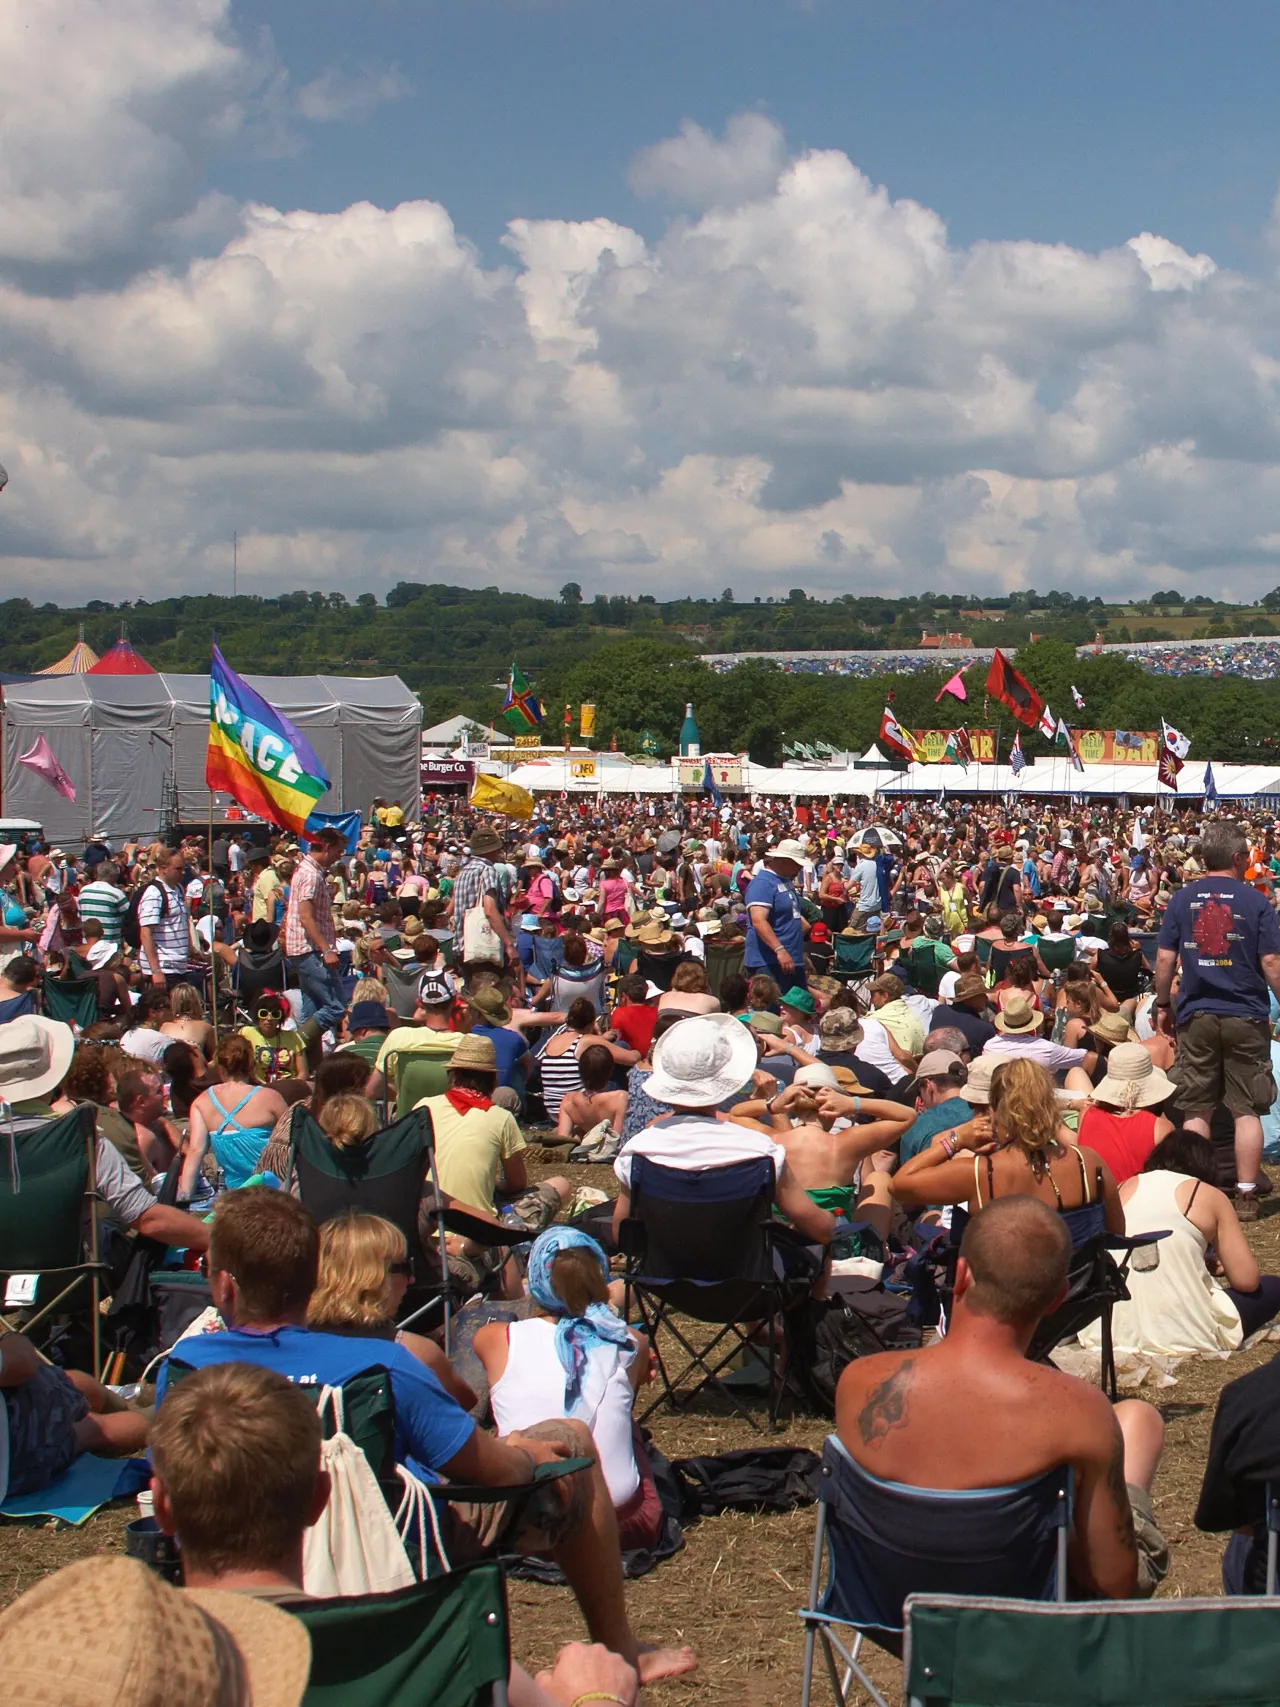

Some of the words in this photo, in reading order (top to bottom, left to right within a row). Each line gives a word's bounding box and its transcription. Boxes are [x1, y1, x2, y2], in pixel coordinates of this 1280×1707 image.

[1081, 738, 1103, 748] DREAM
[927, 748, 941, 757] TIME
[1085, 749, 1099, 759] TIME
[429, 762, 454, 773] Burger
[454, 762, 466, 772] Co.
